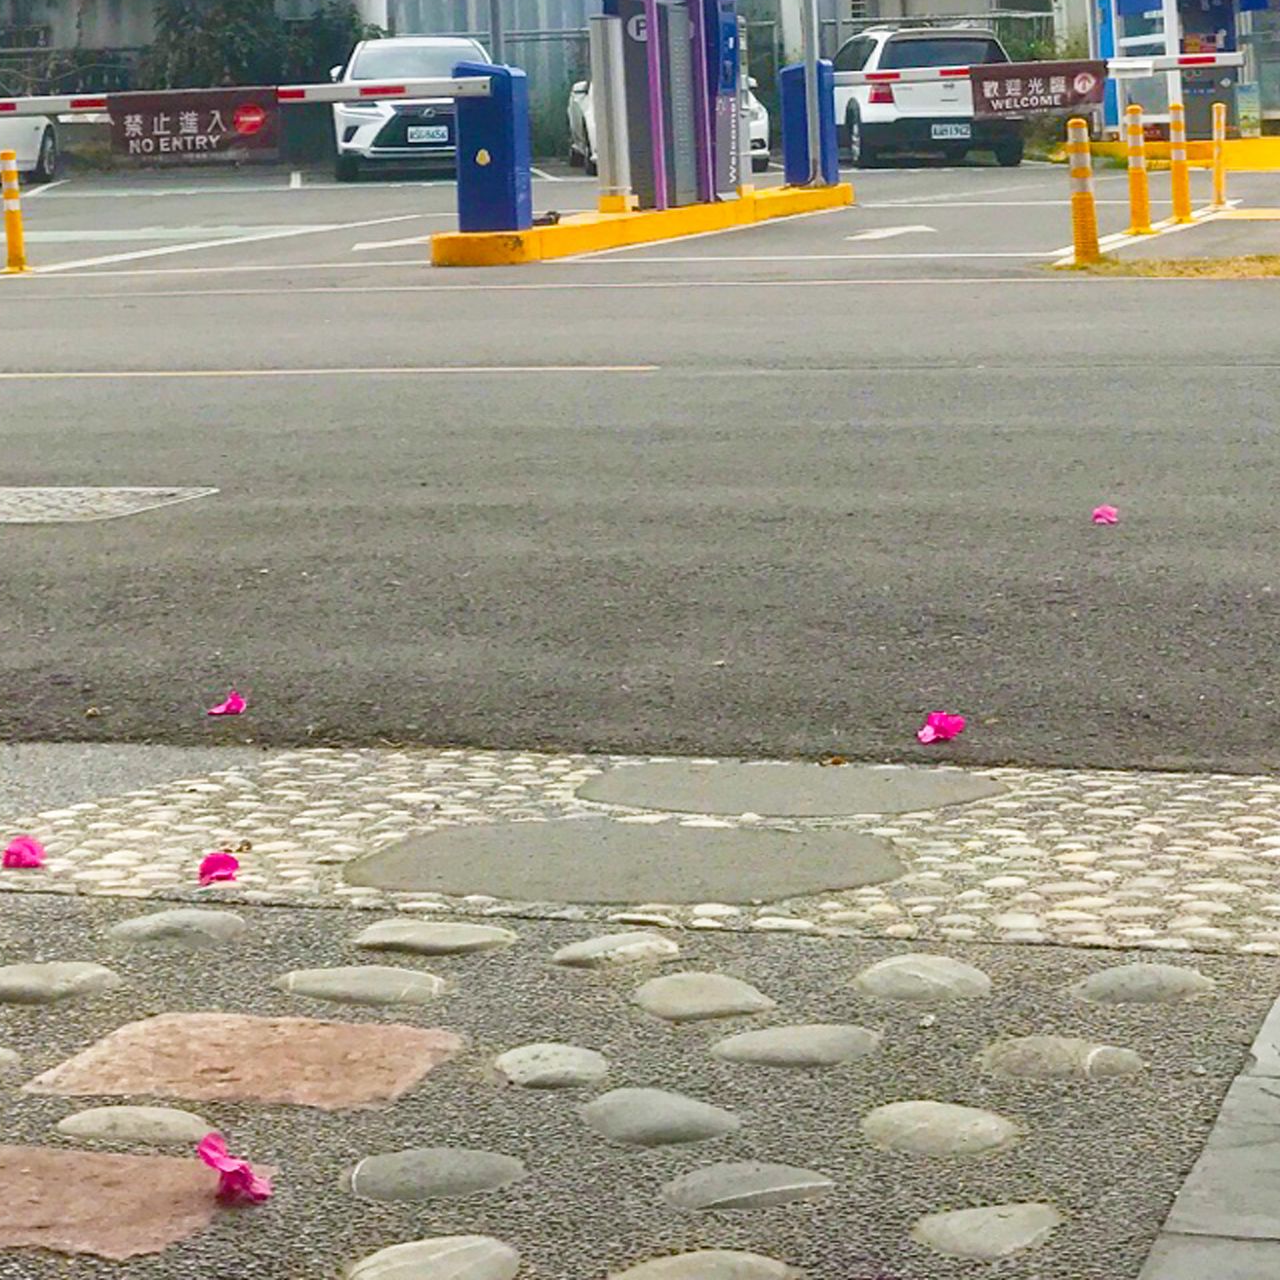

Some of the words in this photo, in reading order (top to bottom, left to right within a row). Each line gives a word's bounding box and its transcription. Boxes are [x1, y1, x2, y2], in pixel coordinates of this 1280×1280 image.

[991, 94, 1062, 110] WELCOME
[123, 110, 227, 137] 禁止進入
[129, 138, 154, 154] NO
[160, 135, 221, 152] ENTRY
